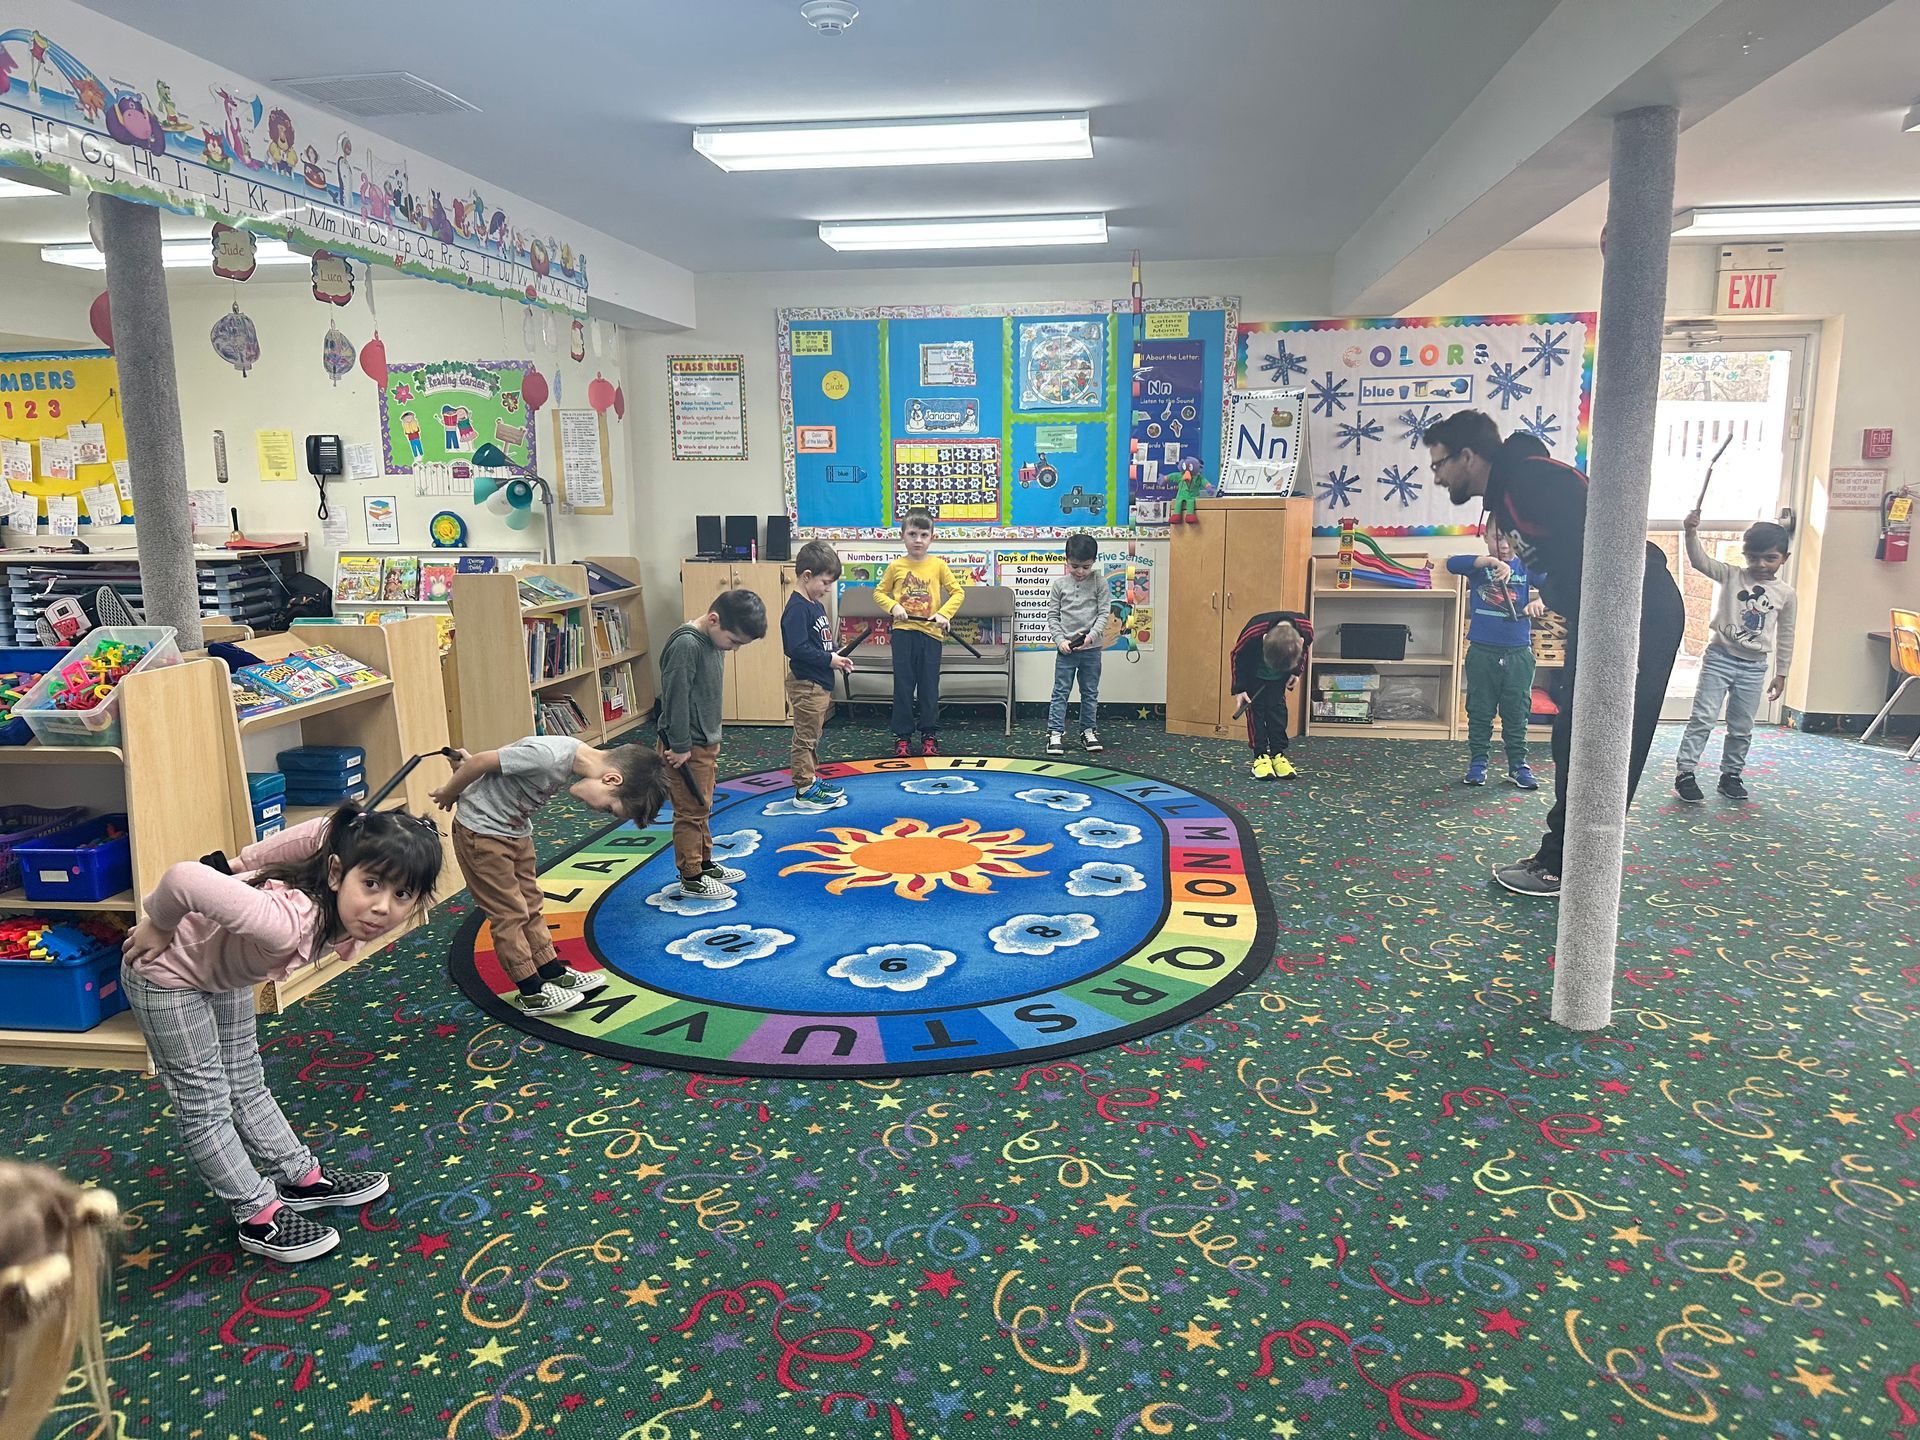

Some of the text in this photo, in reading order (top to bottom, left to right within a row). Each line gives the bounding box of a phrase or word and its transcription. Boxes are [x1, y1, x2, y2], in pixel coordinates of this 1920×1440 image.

[32, 116, 55, 153] Ff
[81, 133, 116, 182] Gg
[132, 147, 161, 181] Hh
[174, 160, 189, 191] Ii
[212, 172, 230, 213] Jj
[247, 183, 269, 213] Kk
[283, 194, 297, 223] Ll
[309, 206, 336, 233] Mm
[342, 212, 361, 239] Nn
[368, 222, 387, 246] Oo
[397, 230, 412, 262] Pp
[417, 236, 434, 269] Qq
[441, 243, 453, 265] Rr
[459, 250, 470, 271] Ss
[480, 256, 490, 277] Tt
[498, 261, 511, 283] Uu
[517, 263, 528, 287] Vv
[533, 272, 548, 293] Ww
[550, 279, 562, 298] Xx
[576, 289, 586, 307] Zz
[220, 243, 245, 256] Jude
[320, 270, 344, 284] Luca
[1727, 273, 1777, 310] EXIT
[1342, 343, 1490, 368] COLORS
[673, 362, 738, 372] CLASS RULES
[0, 370, 76, 392] MBERS
[428, 374, 486, 391] Reading Garden
[825, 382, 844, 391] Circle
[1148, 380, 1172, 395] Nn
[1363, 385, 1395, 398] blue
[4, 399, 61, 420] 1 2 3
[925, 410, 961, 422] January
[1237, 423, 1288, 459] Nn
[1873, 432, 1891, 445] FIRE
[1023, 471, 1030, 480] 11
[1232, 469, 1256, 485] Nn
[1089, 496, 1099, 505] 12
[372, 523, 392, 531] reading
[1344, 535, 1351, 543] 3
[847, 553, 884, 564] Numbers
[968, 554, 985, 564] Year
[998, 555, 1018, 563] Days
[1097, 552, 1154, 567] Five Senses
[876, 566, 883, 575] 6
[1017, 566, 1049, 574] Sunday
[840, 583, 846, 592] 2
[1015, 577, 1050, 586] Monday
[1015, 589, 1051, 597] Tuesday
[841, 618, 847, 627] 4
[876, 618, 883, 628] 9
[1020, 623, 1046, 631] Friday
[841, 635, 847, 643] 5
[874, 635, 886, 645] 10
[1013, 634, 1052, 643] Saturday
[261, 664, 297, 682] BINGO
[873, 760, 912, 770] G
[949, 758, 988, 768] H
[741, 777, 783, 788] E
[1078, 773, 1119, 782] J
[1126, 786, 1169, 798] K
[1043, 794, 1068, 803] 5
[1159, 803, 1201, 816] L
[1183, 825, 1231, 841] M
[603, 836, 656, 848] B
[571, 857, 629, 874] A
[1183, 853, 1232, 869] N
[1091, 875, 1122, 884] 7
[1184, 879, 1237, 897] O
[1183, 911, 1239, 929] P
[1026, 925, 1062, 938] 8
[704, 933, 755, 953] 10
[1147, 946, 1226, 971] Q
[1088, 978, 1169, 1006] R
[1014, 1004, 1077, 1034] S
[641, 1010, 709, 1043] V
[780, 1024, 858, 1056] U
[911, 1020, 977, 1051] T
